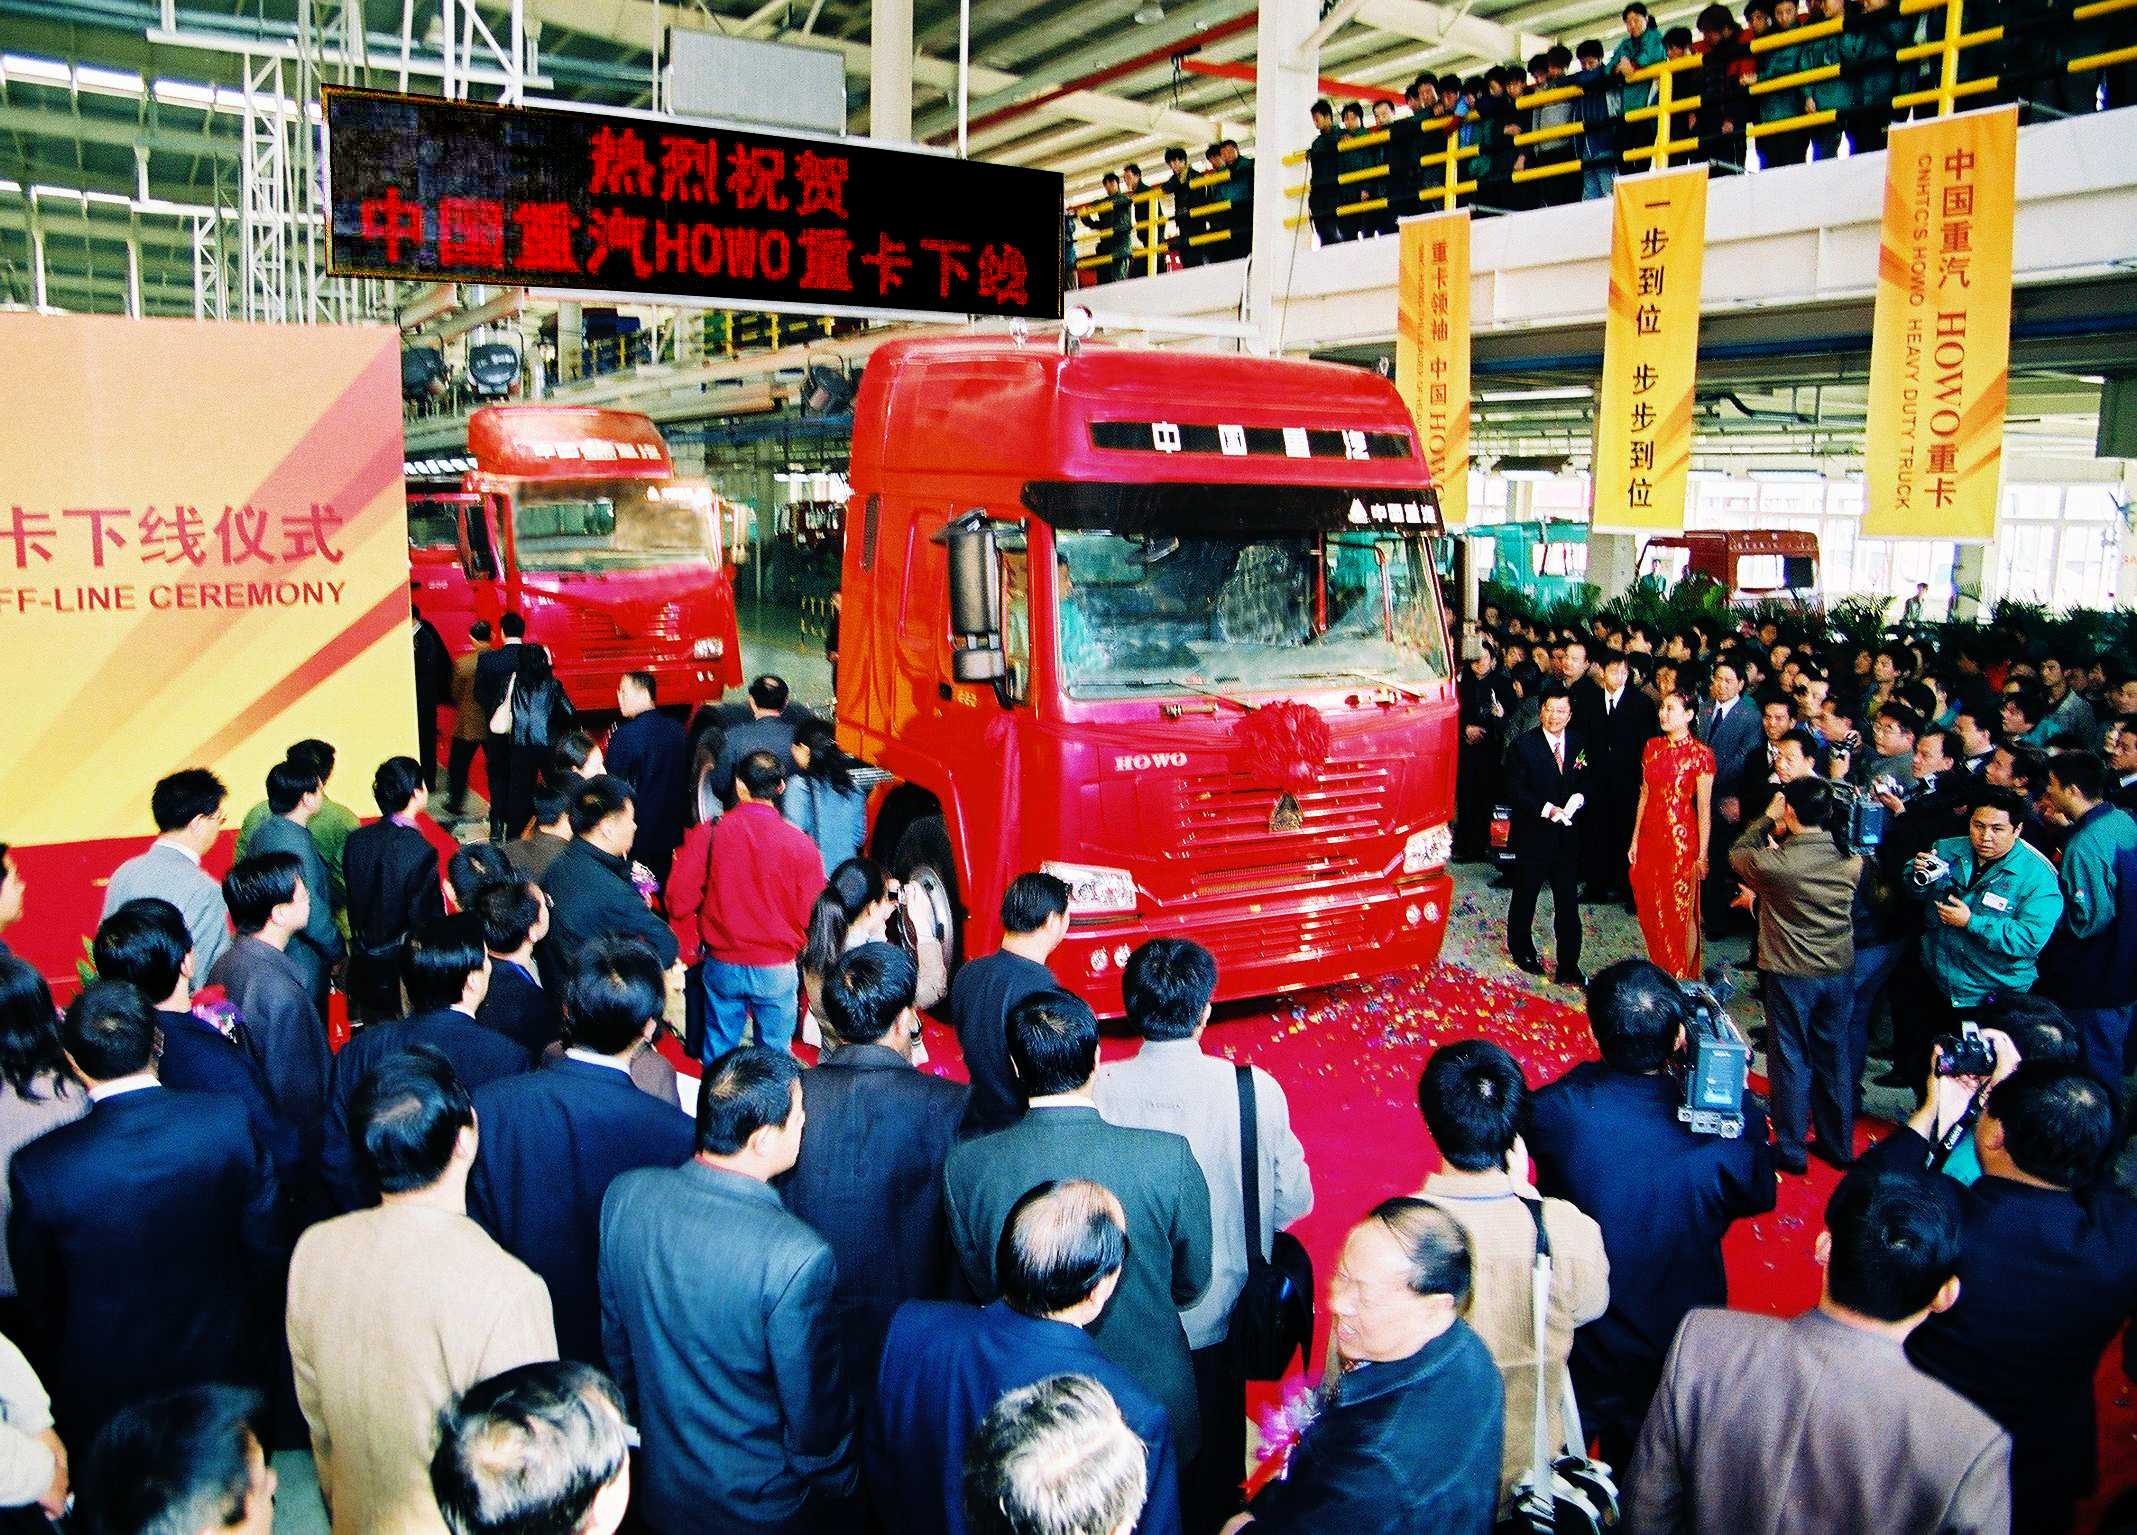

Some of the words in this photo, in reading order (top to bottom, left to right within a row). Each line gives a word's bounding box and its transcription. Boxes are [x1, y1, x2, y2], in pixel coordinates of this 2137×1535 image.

[588, 124, 849, 219] 热烈祝贺
[1938, 148, 1975, 290] 中国重汽
[1431, 240, 1448, 343] 重卡领袖
[1635, 201, 1670, 338] 一步到位
[1909, 247, 1926, 307] HOWO
[1905, 318, 1922, 383] HEAVY
[1627, 363, 1659, 509] 步步到位
[1901, 388, 1918, 440] DUTY
[1896, 445, 1914, 511] TRUCK
[0, 503, 344, 569] 卡下线仪式
[149, 581, 346, 611] CEREMONY
[1113, 752, 1188, 772] HOWO
